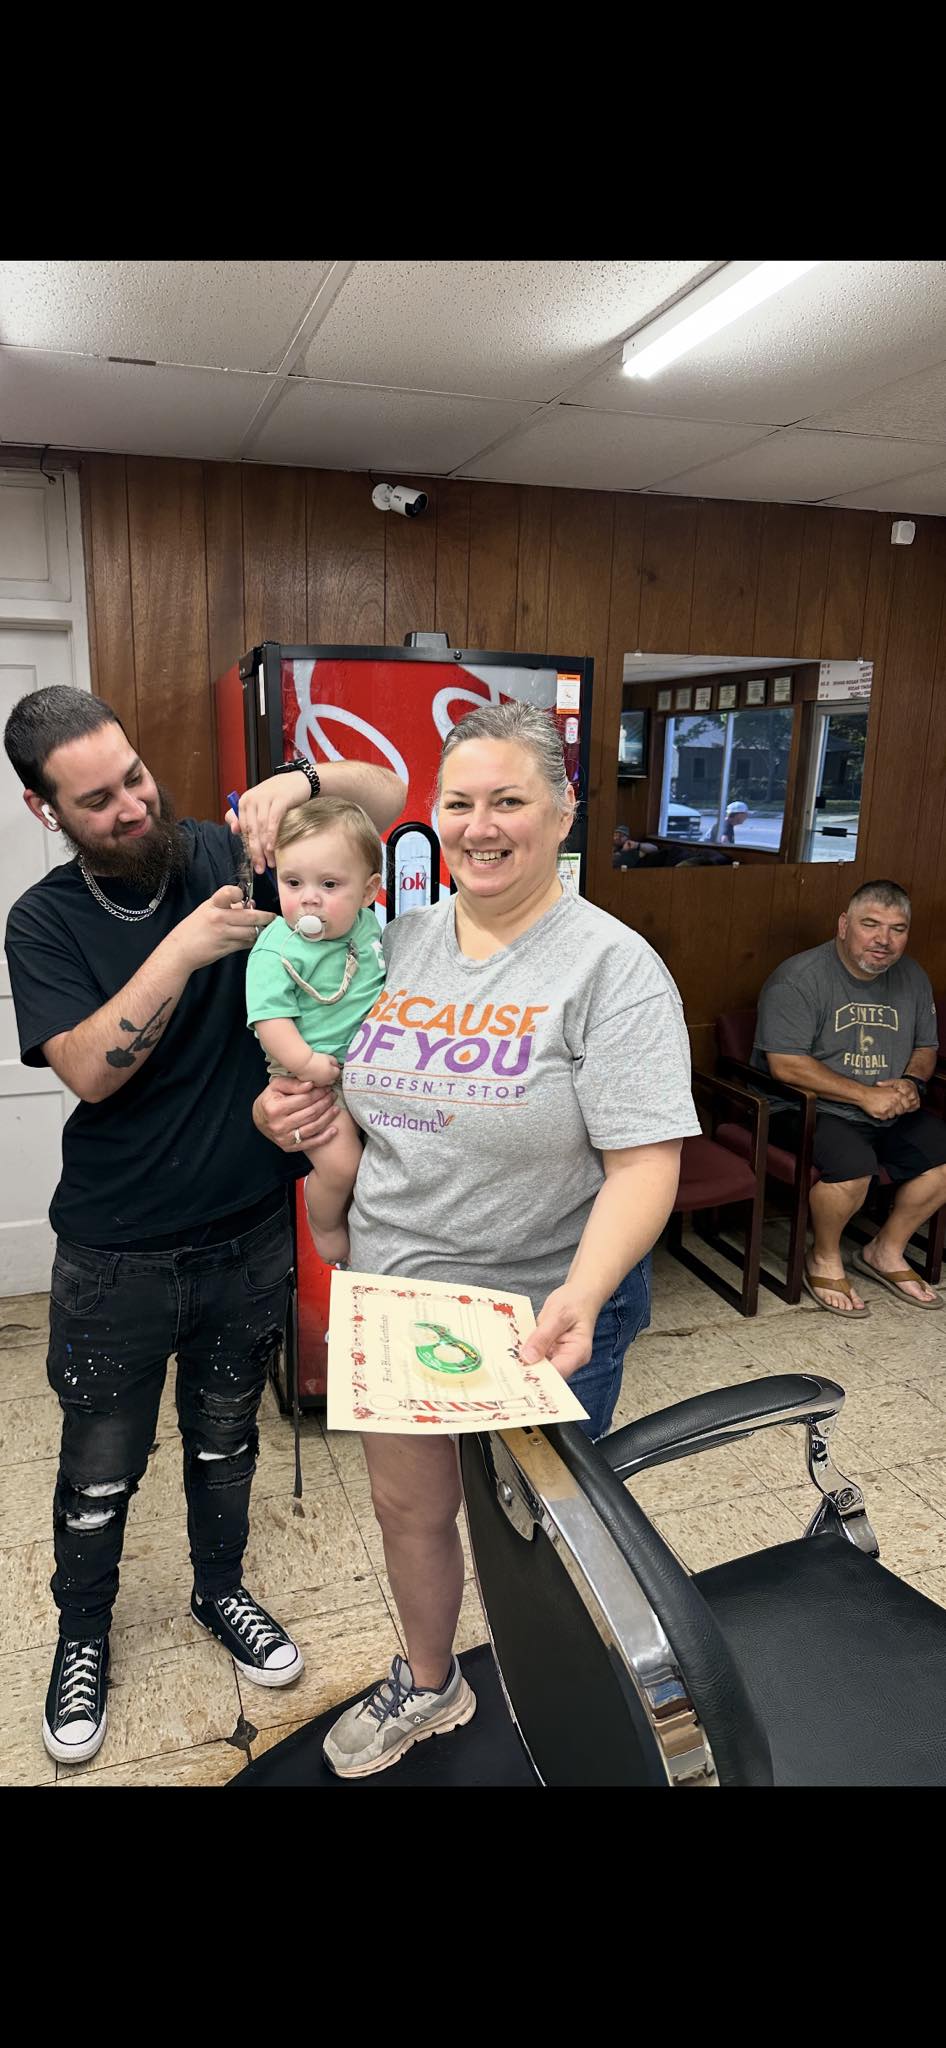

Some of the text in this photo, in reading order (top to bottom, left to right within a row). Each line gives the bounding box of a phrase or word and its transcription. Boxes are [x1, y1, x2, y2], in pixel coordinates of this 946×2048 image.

[400, 872, 426, 891] ok
[345, 1022, 532, 1076] OF YOU
[366, 1073, 456, 1095] DOESN'T
[467, 1084, 526, 1099] STOP
